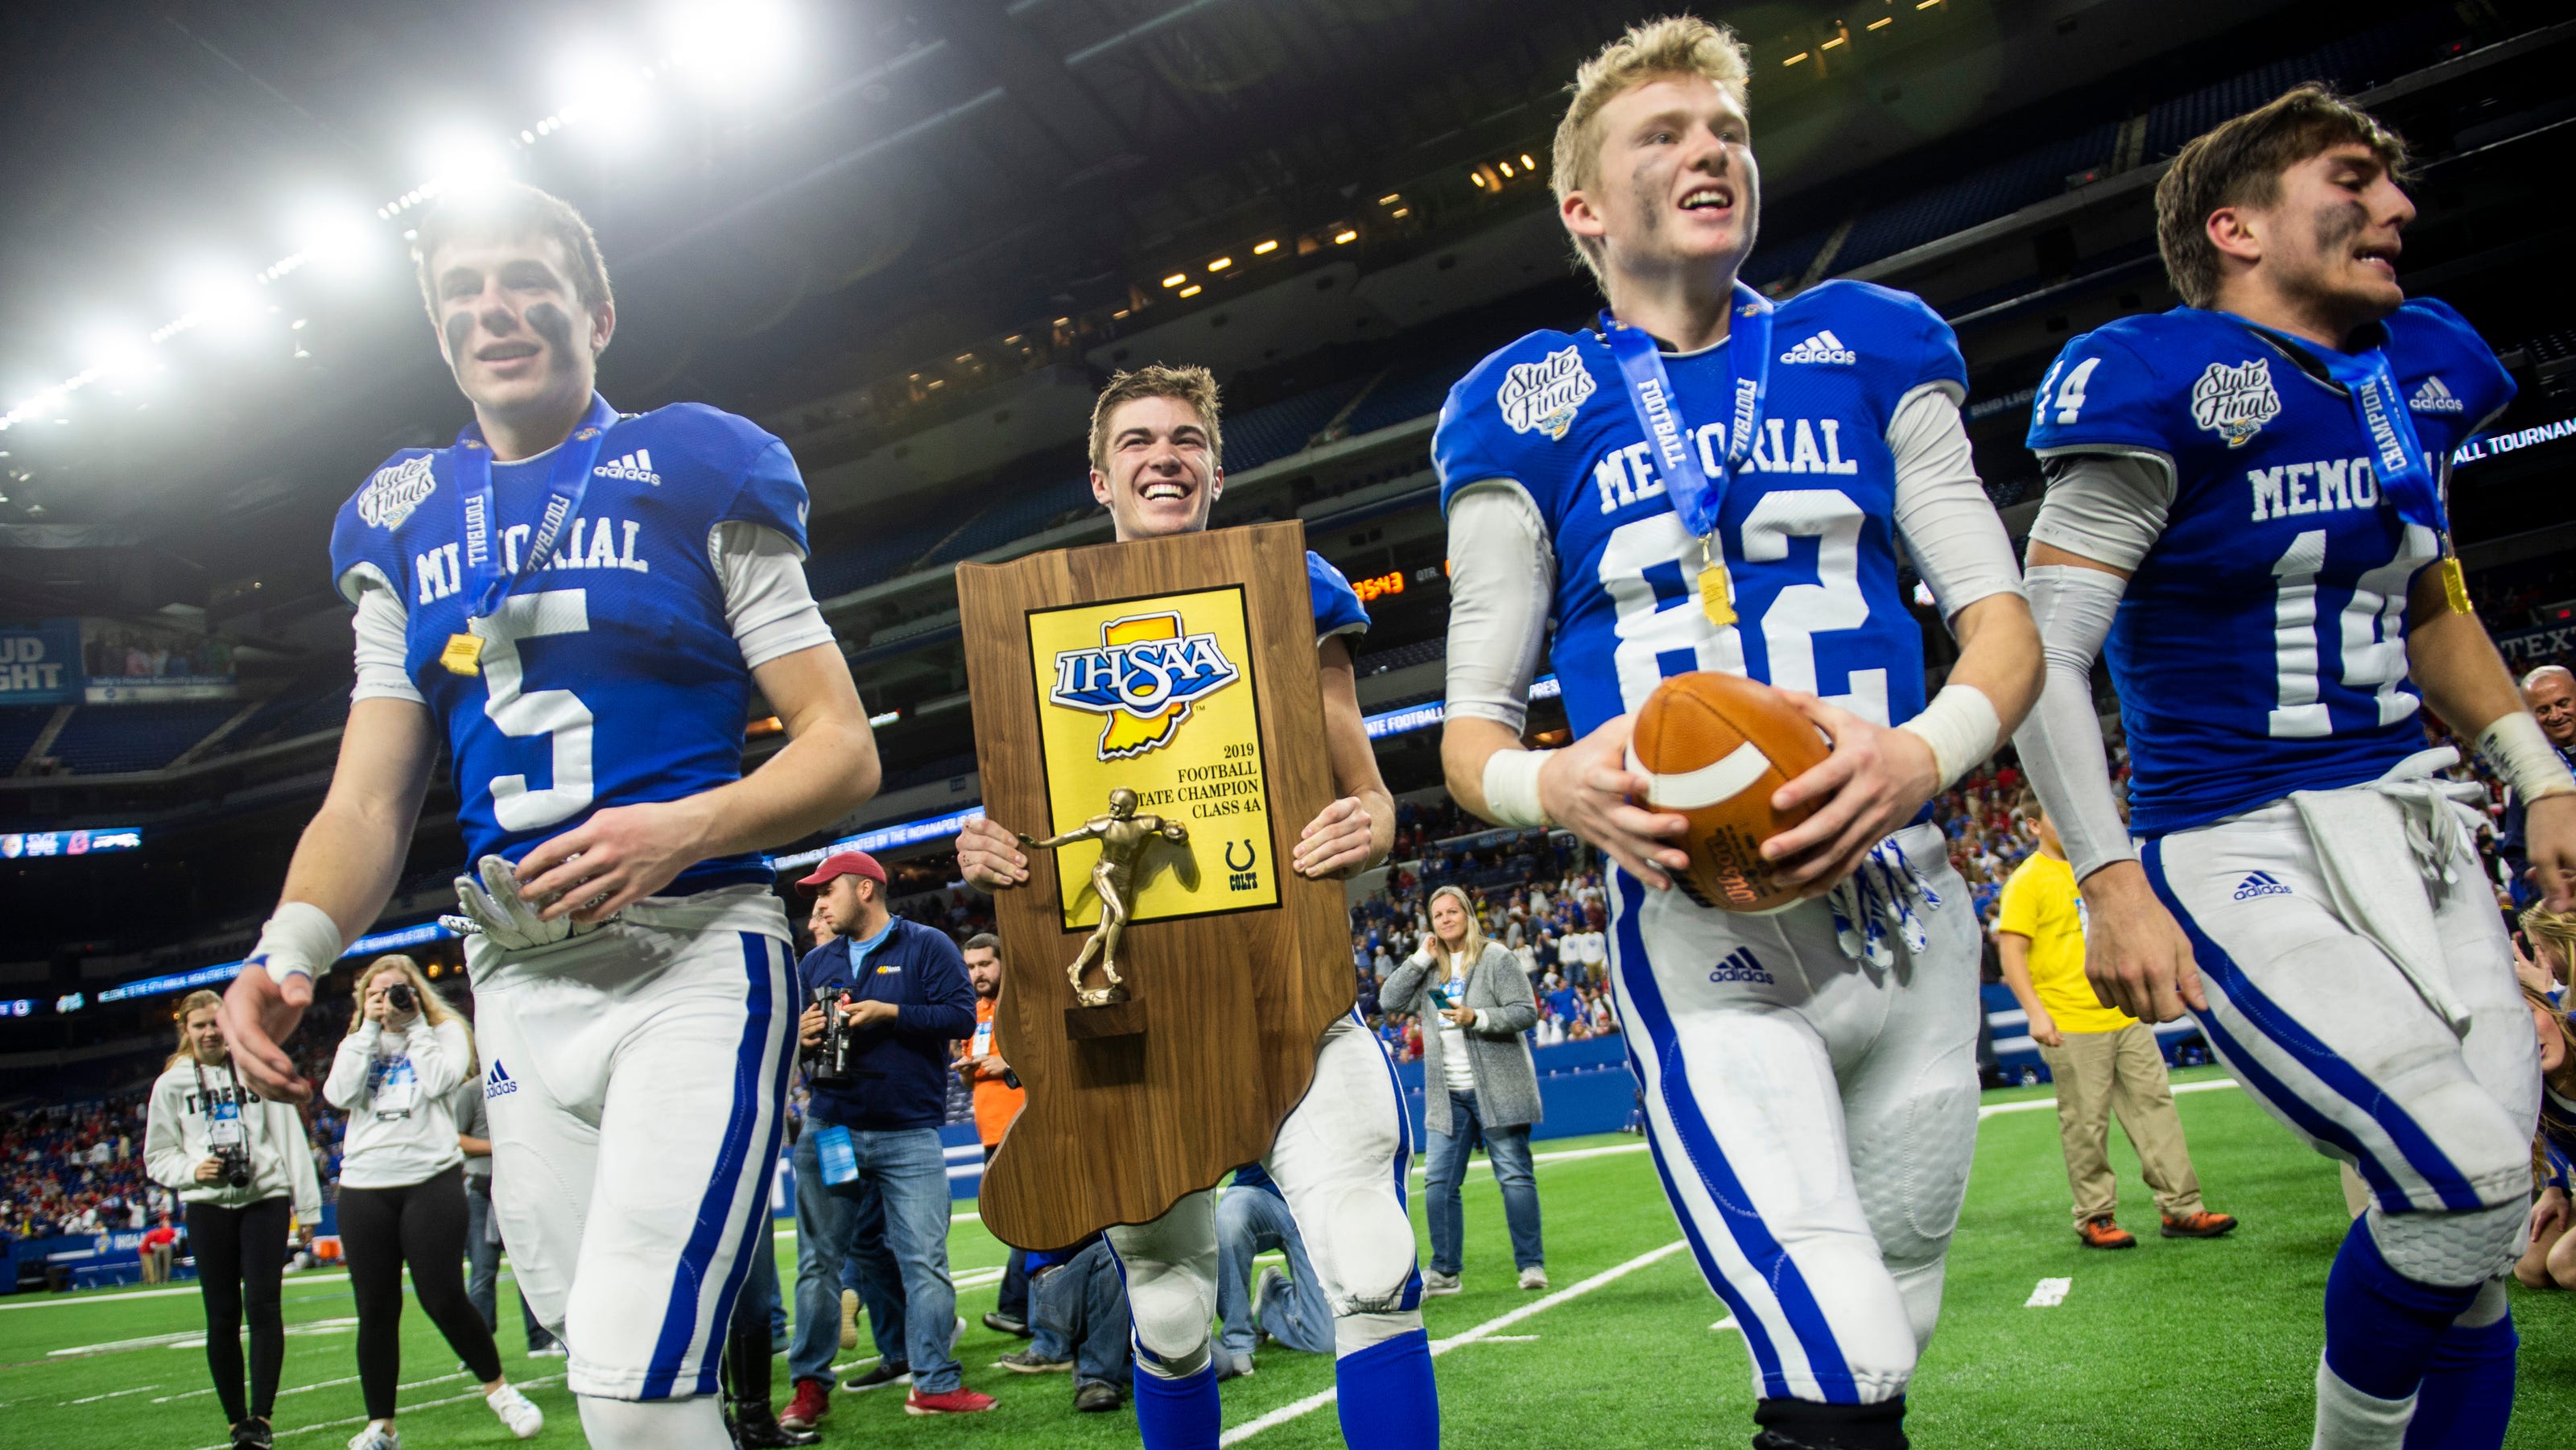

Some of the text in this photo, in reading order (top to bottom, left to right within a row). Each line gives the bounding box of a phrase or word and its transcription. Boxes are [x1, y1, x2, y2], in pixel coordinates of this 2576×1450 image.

[1503, 347, 1576, 404] State
[1780, 348, 1856, 366] adidas
[2198, 361, 2267, 398] State
[1507, 370, 1591, 429] Finals
[2195, 386, 2277, 427] Finals
[2409, 397, 2464, 411] adidas
[1637, 377, 1687, 470] FOOTBALL
[1727, 377, 1757, 464] FOOTBALL
[2359, 381, 2407, 473] CHAMPION
[2451, 417, 2576, 465] ALL TOURNAM
[361, 455, 432, 501] State
[593, 464, 661, 485] adidas
[361, 472, 431, 524] Finals
[465, 494, 487, 568] FOOTBALL
[526, 494, 570, 572] FOOTBALL
[1599, 490, 1890, 728] 82
[2268, 523, 2439, 737] 14
[2500, 626, 2576, 661] TEX
[0, 637, 44, 663] UD
[1056, 632, 1233, 707] IHSAA
[472, 589, 593, 832] 5
[1387, 706, 1445, 733] FOOTBALL
[1224, 742, 1254, 758] 2019
[1178, 761, 1257, 783] FOOTBALL
[1137, 779, 1259, 808] TATE CHAMPION
[1192, 797, 1261, 819] CLASS 4A
[890, 829, 906, 844] THE
[1229, 872, 1259, 892] COLTS
[2233, 883, 2293, 901] adidas
[1709, 968, 1775, 985] adidas
